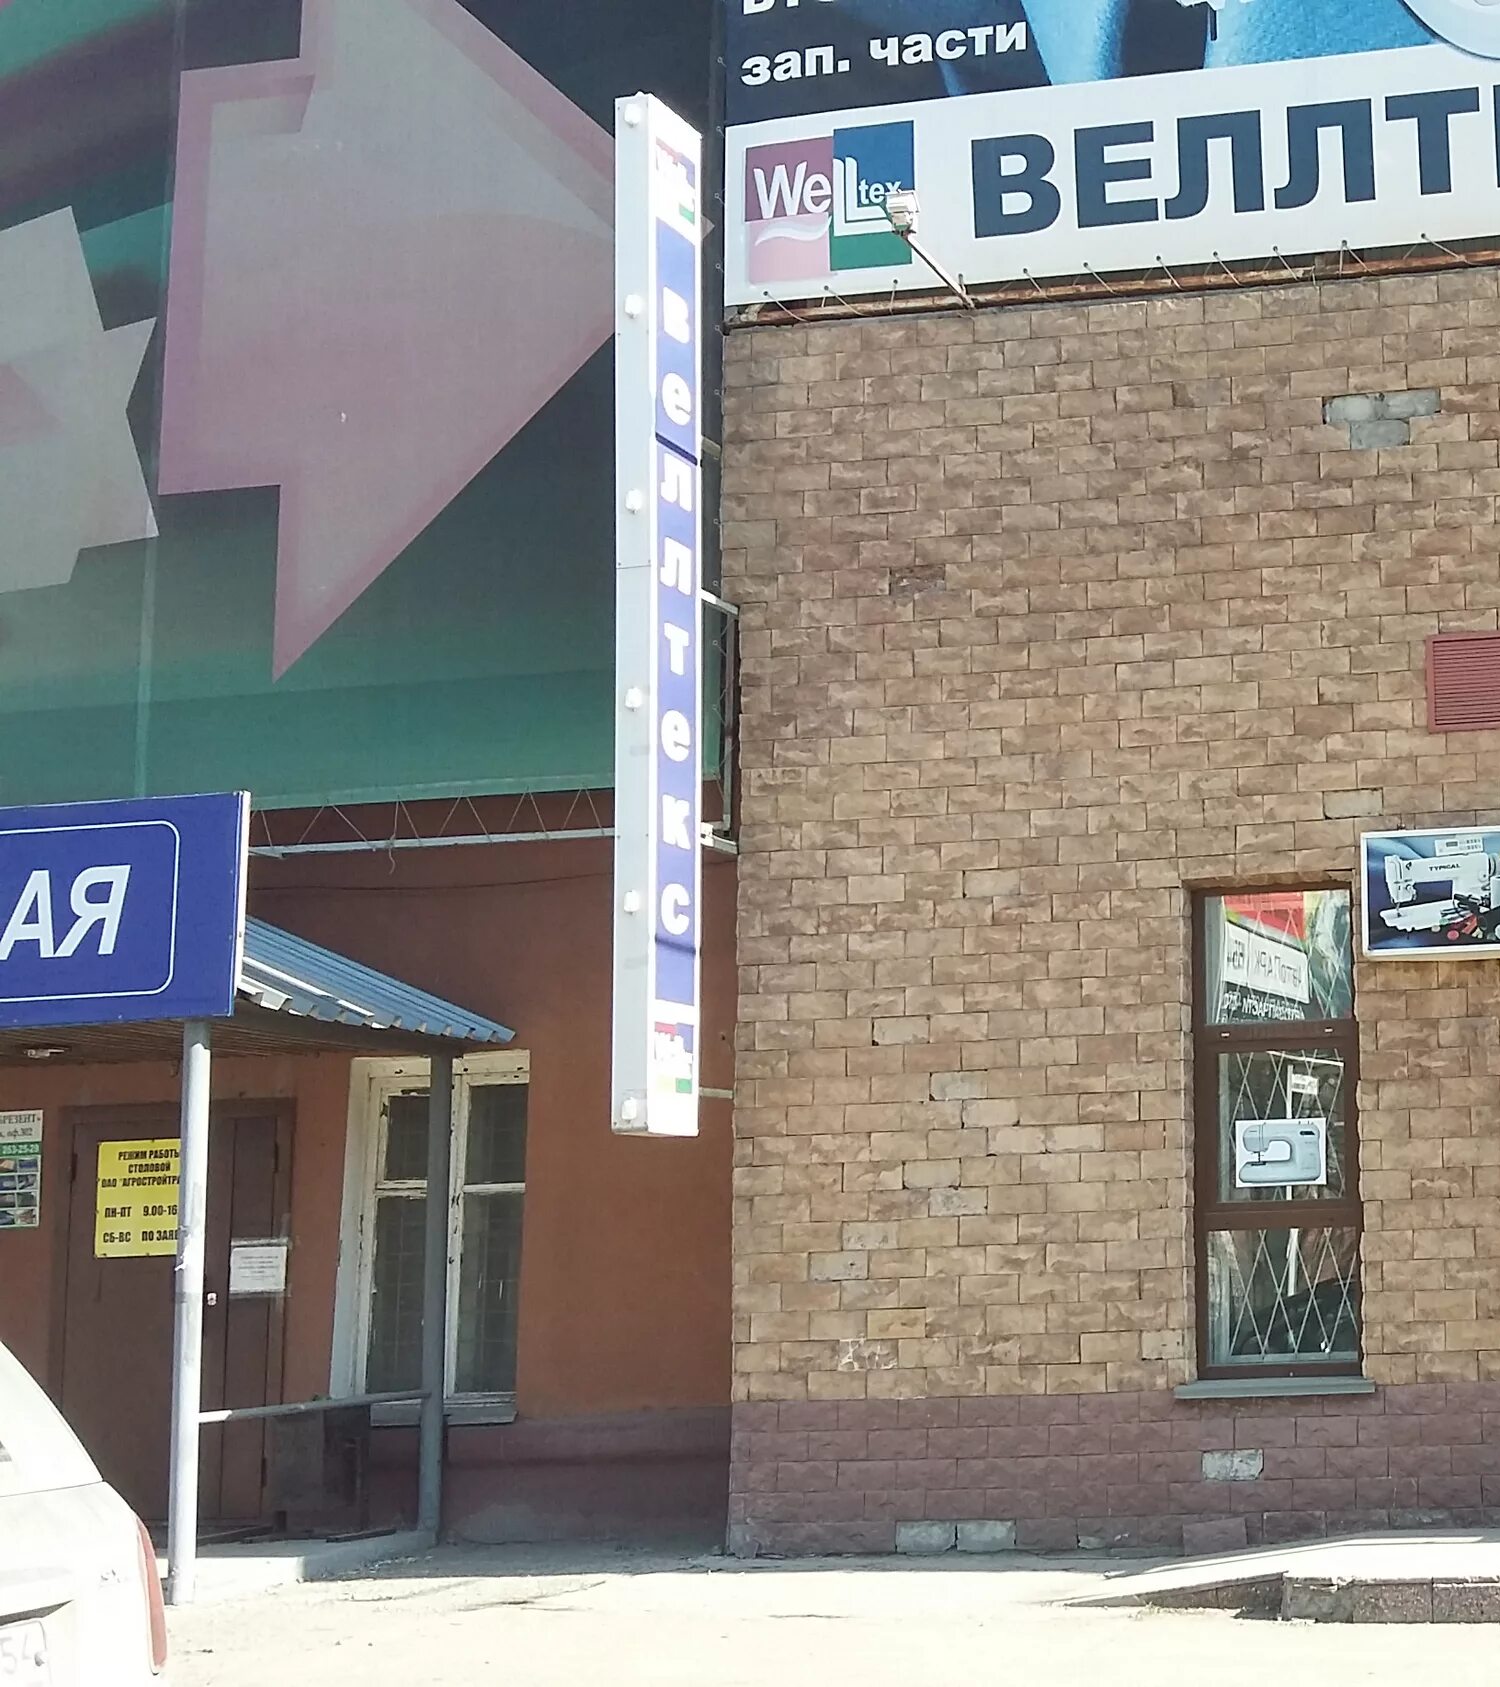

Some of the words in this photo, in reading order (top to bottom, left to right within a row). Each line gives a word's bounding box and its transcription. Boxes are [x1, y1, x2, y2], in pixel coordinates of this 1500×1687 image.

[741, 46, 851, 86] зап.
[869, 22, 1028, 66] части
[118, 1151, 147, 1160] РЕЖИМ
[128, 1162, 171, 1173] СТОЛОВОЙ
[105, 1206, 132, 1218] ПН-ПТ
[103, 1232, 131, 1243] СБ-ВС
[141, 1231, 155, 1241] ПО
